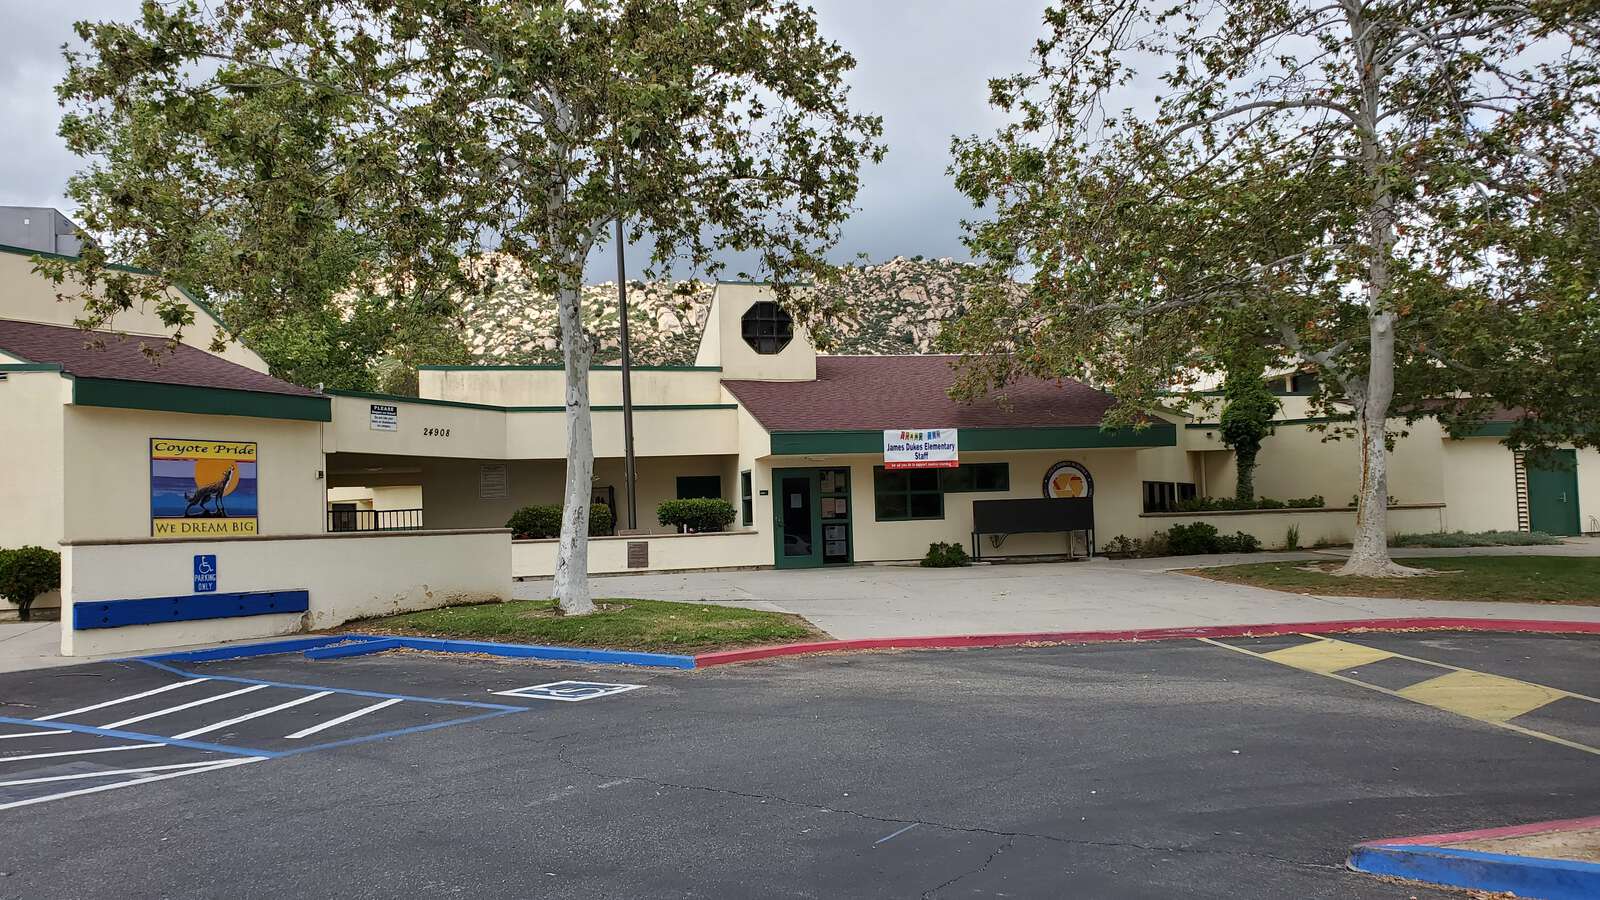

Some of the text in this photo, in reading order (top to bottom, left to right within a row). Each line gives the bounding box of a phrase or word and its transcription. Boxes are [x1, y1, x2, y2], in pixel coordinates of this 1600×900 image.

[423, 427, 450, 437] 24908
[154, 442, 254, 455] Coyote Pride
[887, 442, 955, 452] James Dukes Elementary
[915, 452, 928, 460] Staff
[155, 521, 253, 533] WE DREAM BIG
[194, 574, 216, 582] PARKING
[198, 582, 213, 591] ONLY
